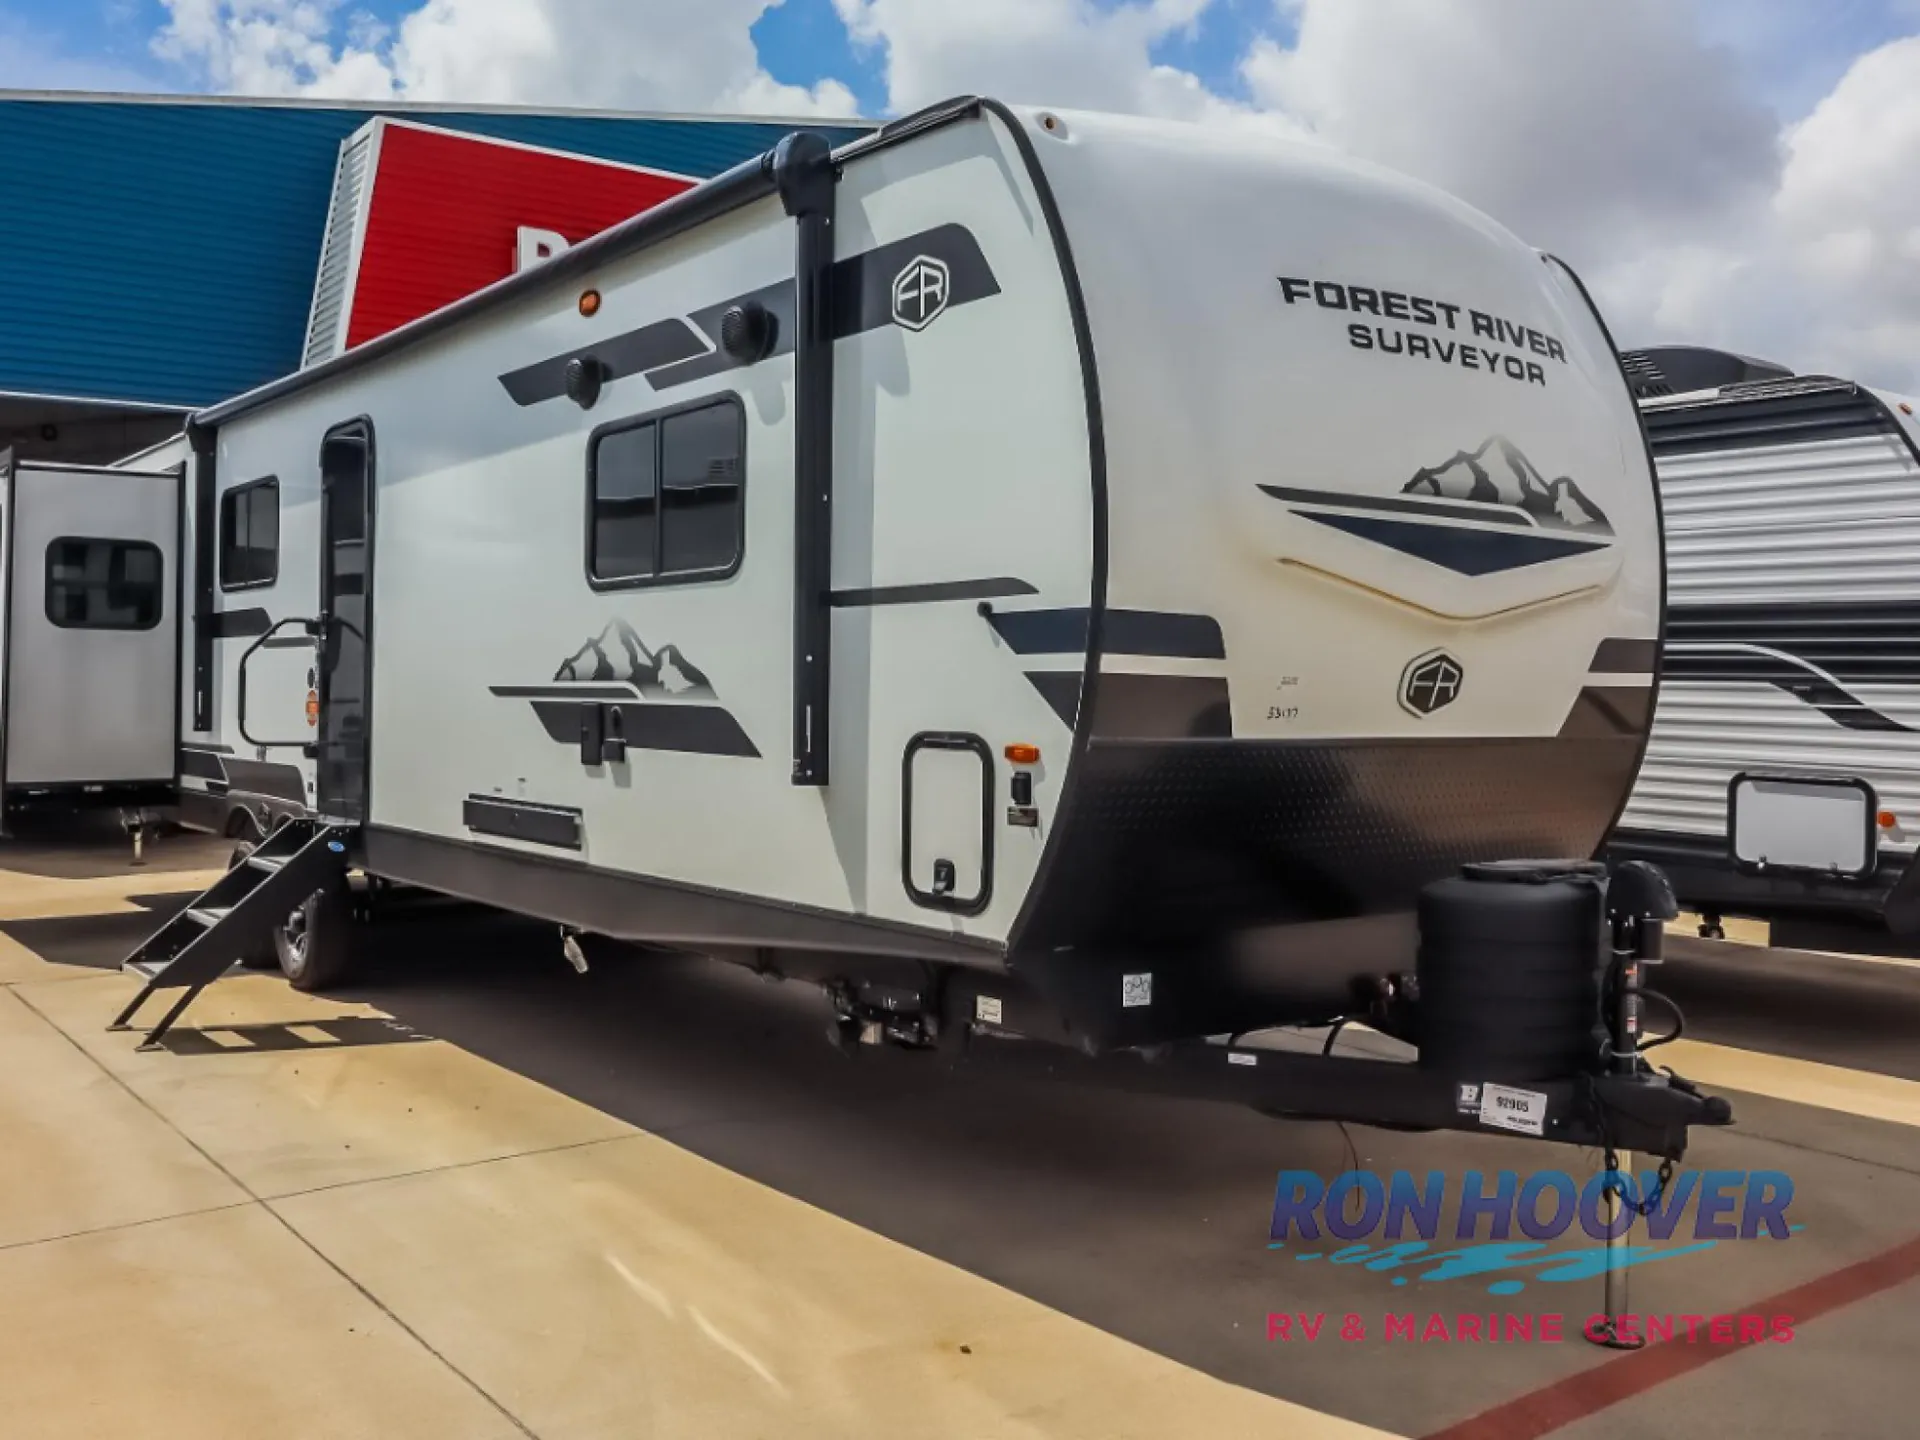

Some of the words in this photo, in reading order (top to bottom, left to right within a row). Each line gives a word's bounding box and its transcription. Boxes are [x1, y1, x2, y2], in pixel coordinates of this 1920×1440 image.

[1277, 276, 1460, 330] FOREST
[1468, 309, 1567, 364] RIVER
[1348, 323, 1546, 386] SURVEYOR
